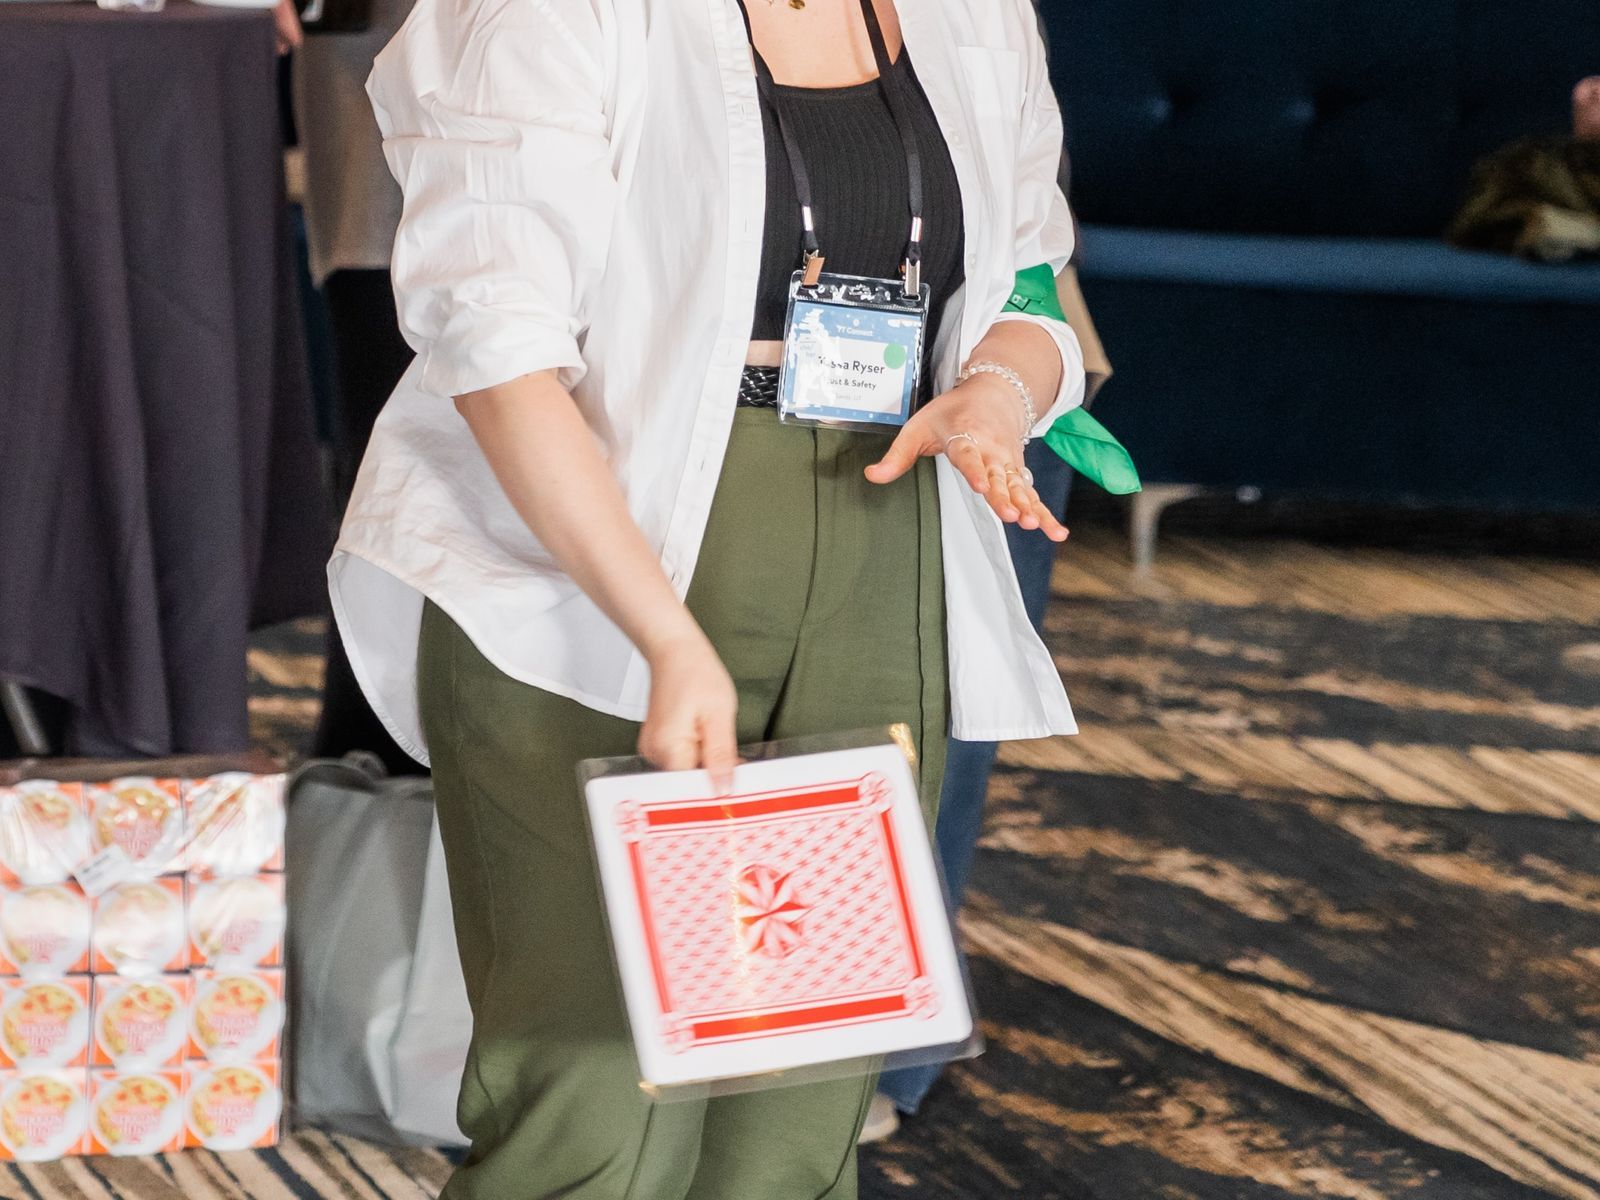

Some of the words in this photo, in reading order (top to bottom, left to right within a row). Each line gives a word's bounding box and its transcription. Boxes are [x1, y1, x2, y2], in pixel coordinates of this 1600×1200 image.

[852, 360, 886, 375] Ryser
[843, 378, 850, 387] &
[851, 379, 878, 391] Safety
